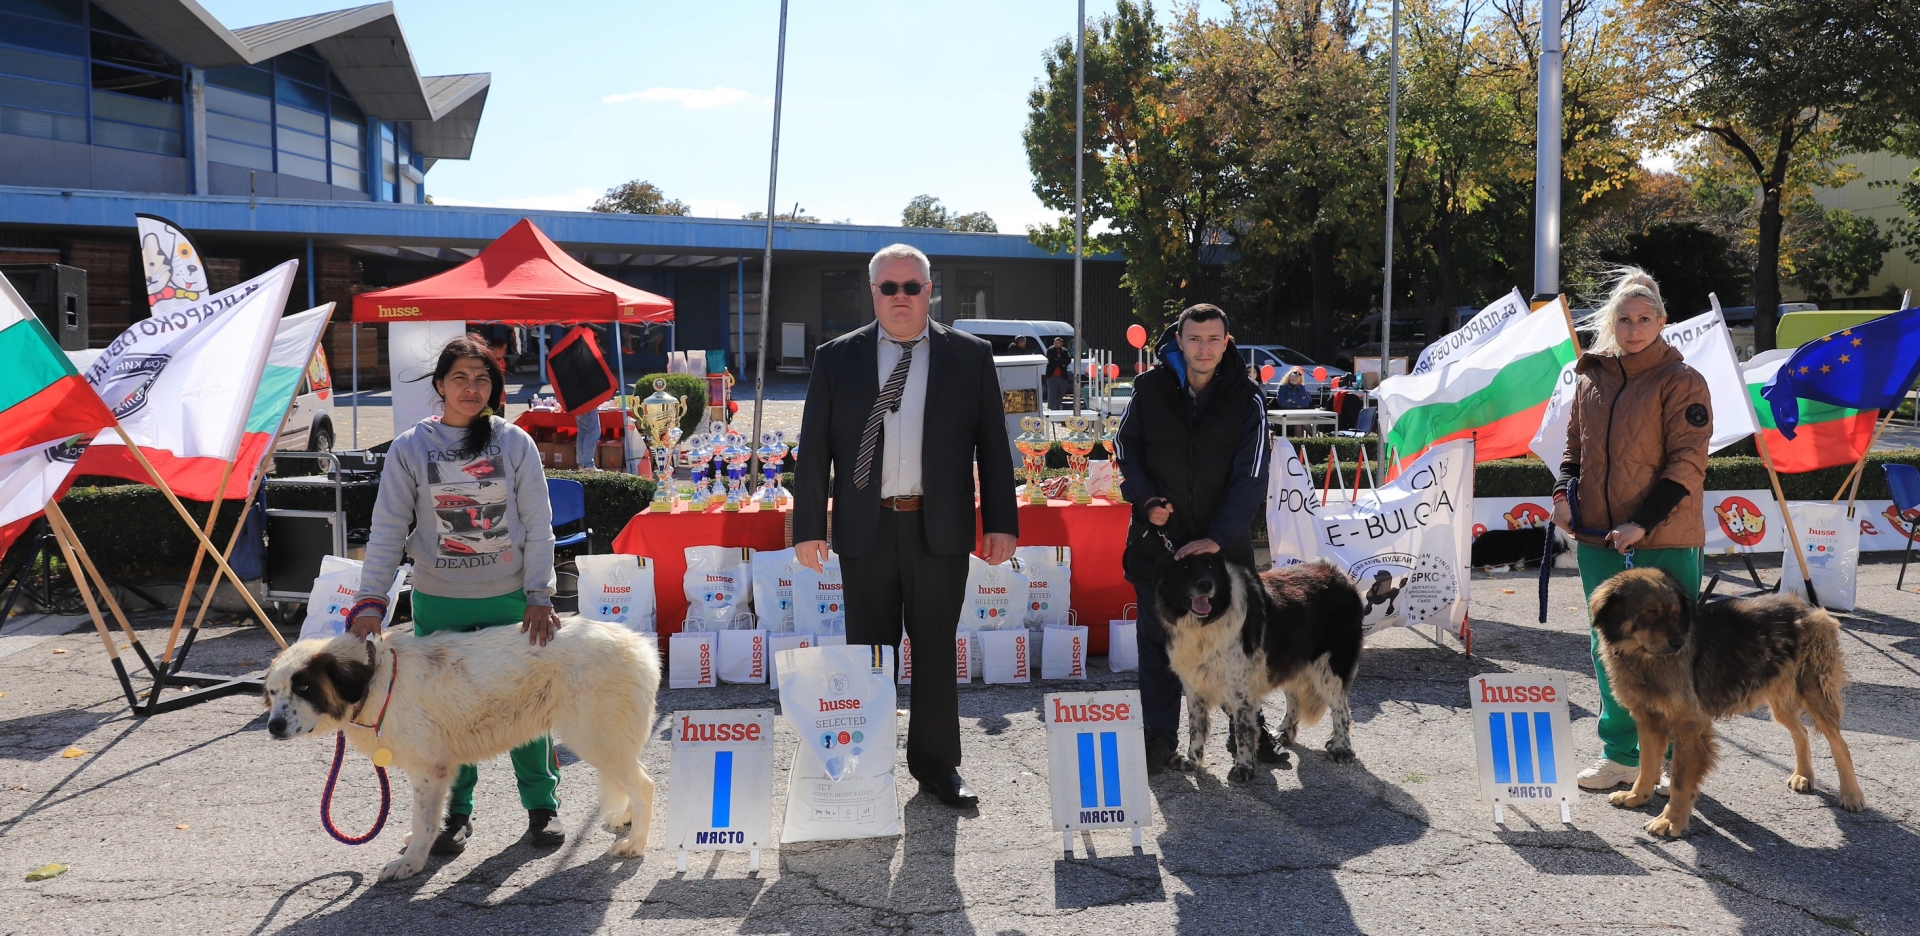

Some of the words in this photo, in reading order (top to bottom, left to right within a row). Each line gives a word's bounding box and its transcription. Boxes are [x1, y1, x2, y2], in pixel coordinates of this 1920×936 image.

[435, 553, 498, 569] DEADLY
[1381, 555, 1413, 564] ПУДЕЛИ
[1411, 572, 1440, 583] БРКС
[336, 584, 357, 596] hus
[698, 643, 712, 685] husse
[749, 635, 762, 679] husse
[1013, 636, 1027, 679] husse
[1069, 636, 1082, 677] husse
[1478, 679, 1557, 704] husse
[818, 698, 861, 712] husse
[1053, 698, 1130, 723] husse
[680, 717, 761, 742] husse
[815, 716, 867, 729] SELECTED
[813, 783, 832, 791] DIET
[1508, 786, 1553, 799] МЯСТО
[1079, 809, 1125, 824] МЯСТО
[696, 831, 745, 845] МЯСТО
